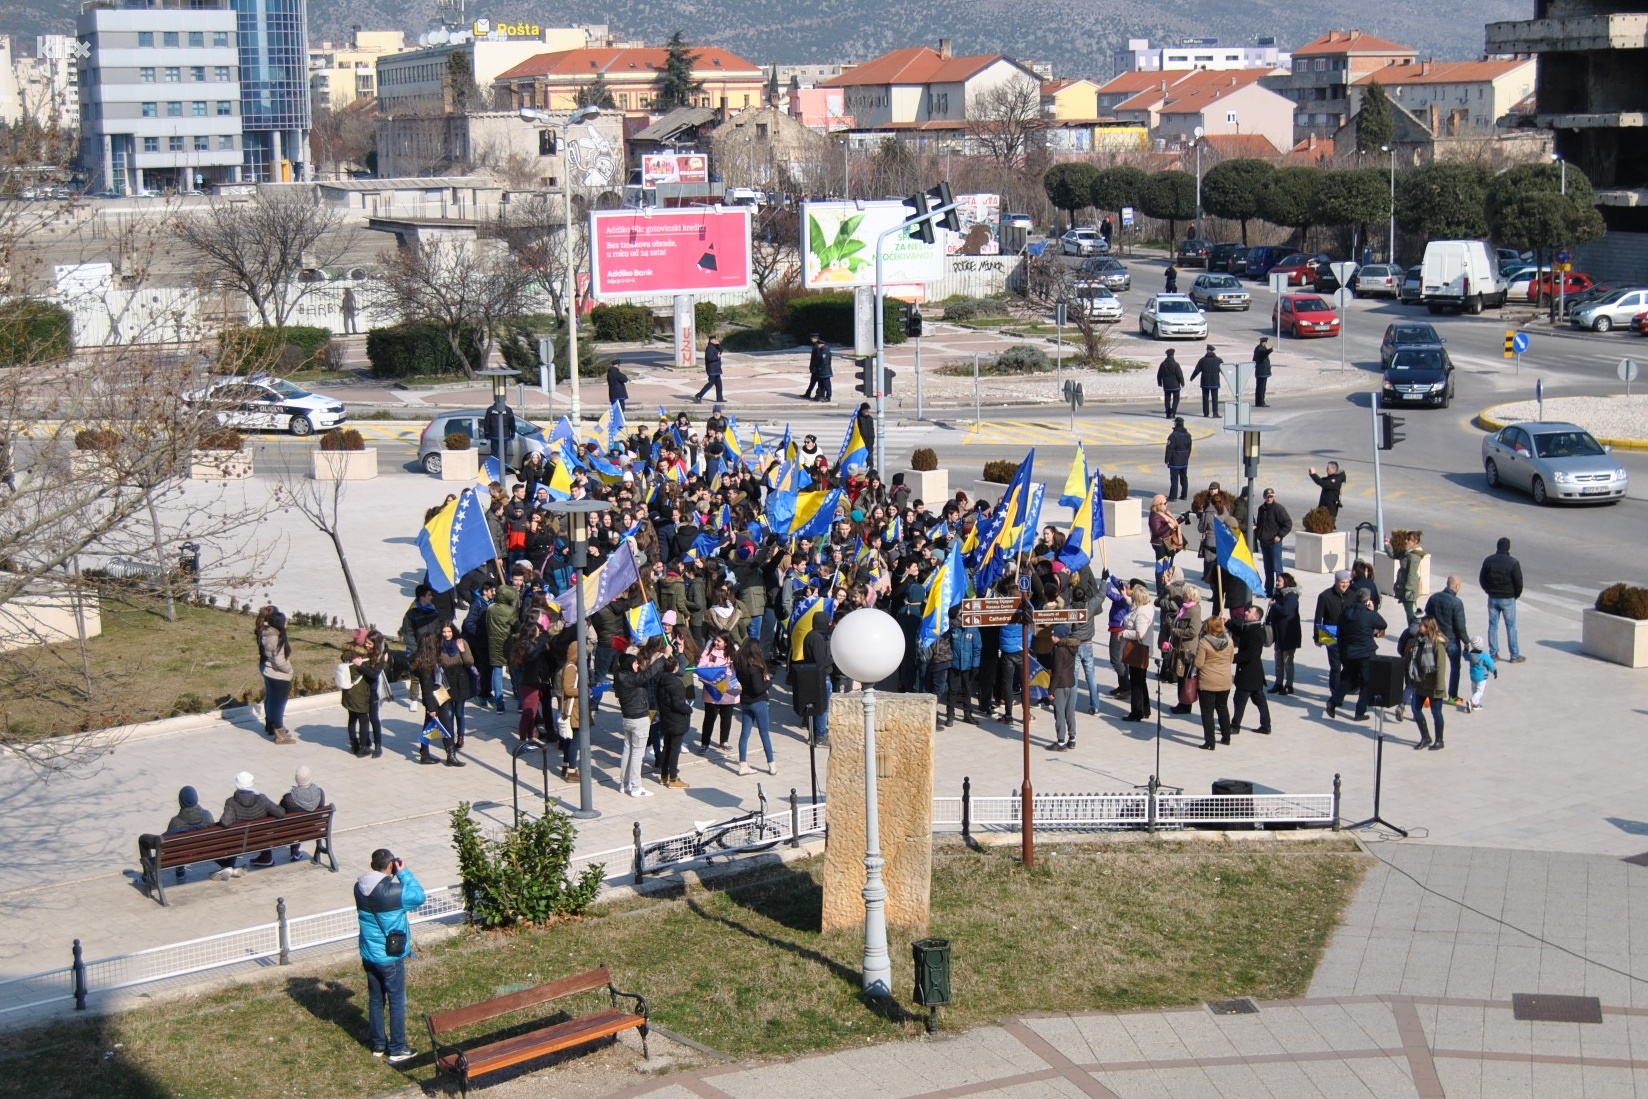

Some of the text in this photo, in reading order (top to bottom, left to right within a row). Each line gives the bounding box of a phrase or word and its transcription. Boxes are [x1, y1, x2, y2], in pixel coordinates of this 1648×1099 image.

[497, 22, 540, 36] Pošta
[606, 225, 630, 234] Addiko
[645, 224, 681, 235] gotovinski
[606, 241, 620, 249] Bez
[651, 239, 677, 248] obrade,
[895, 243, 906, 251] ZA
[612, 250, 630, 258] roku
[630, 249, 640, 257] od
[640, 250, 649, 258] 24
[649, 248, 667, 257] sata!
[606, 269, 653, 278] Addiko Bank
